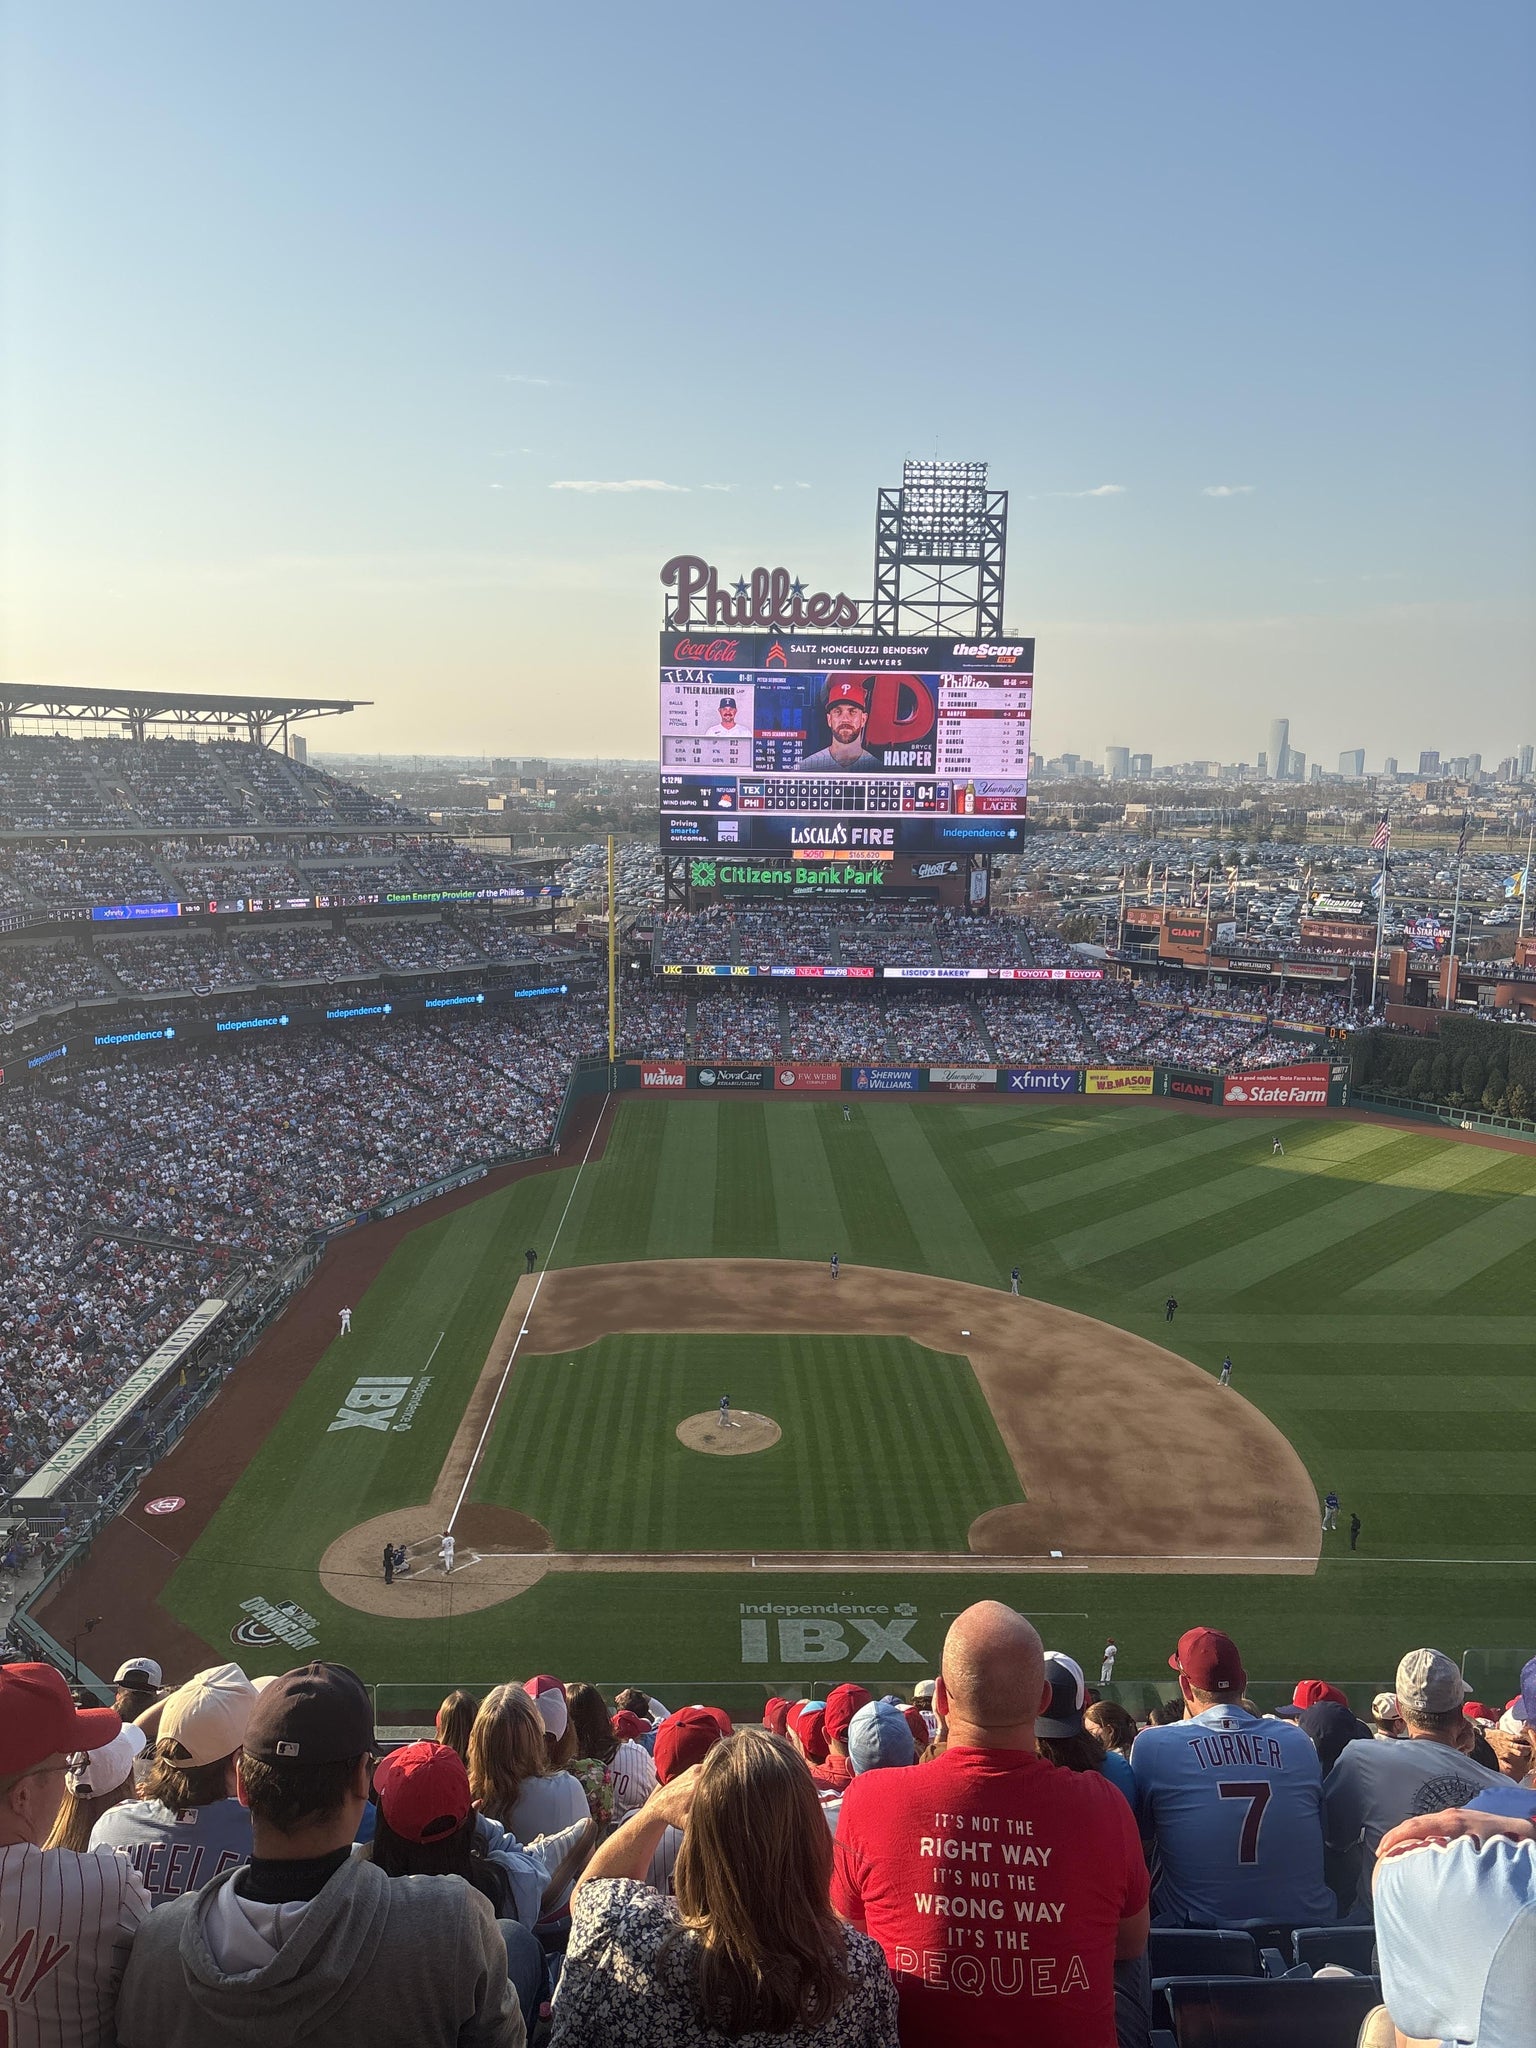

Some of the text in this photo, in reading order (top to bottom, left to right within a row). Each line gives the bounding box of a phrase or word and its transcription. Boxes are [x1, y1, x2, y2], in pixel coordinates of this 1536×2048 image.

[660, 554, 859, 628] Phillies
[790, 645, 929, 655] SALTZ MONGELUZZI BENDESKY
[952, 644, 1024, 656] theScore
[664, 669, 714, 684] TEXAS
[940, 674, 989, 689] Phillies
[683, 686, 735, 695] TYLER ALEXANDER
[883, 751, 932, 767] HARPER
[743, 786, 760, 794] TEX
[918, 786, 933, 799] 0-1
[978, 782, 1025, 795] Yuengling
[744, 799, 760, 807] PHI
[983, 802, 1018, 811] LAGER
[670, 820, 698, 828] Driving
[851, 828, 894, 845] FIRE
[943, 828, 1006, 839] Independence
[720, 866, 884, 885] Citizens Bank Park
[919, 861, 949, 877] GHOST
[386, 893, 411, 902] Clean
[412, 892, 441, 902] Energy
[442, 890, 476, 899] Provider
[477, 890, 486, 898] of
[486, 889, 498, 898] the
[499, 888, 525, 897] Phillies
[1315, 893, 1365, 909] Fitzpatrick
[103, 909, 124, 917] xfinity
[151, 907, 168, 915] Speed
[1171, 928, 1201, 938] GIANT
[1404, 925, 1452, 938] ALL STAR GAME
[662, 965, 750, 975] UKG UKG UKG
[901, 969, 970, 977] LISCIO'S BAKERY
[1016, 970, 1050, 978] TOYOTA
[514, 986, 560, 998] Independence
[425, 995, 476, 1008] Independence
[326, 1005, 382, 1019] Independence
[216, 1016, 278, 1031] Independence
[94, 1030, 162, 1046] Independence
[1339, 1031, 1347, 1040] 15
[28, 1049, 62, 1069] Independence
[643, 1072, 683, 1086] Wawa
[717, 1070, 762, 1081] NovaCare
[798, 1073, 837, 1081] F.W. WEBB
[870, 1069, 912, 1079] SHERWIN
[942, 1070, 985, 1081] Yuengling
[1011, 1071, 1071, 1090] xfinity
[869, 1079, 913, 1089] WILLIAMS.
[1171, 1082, 1213, 1097] GIANT
[1460, 1120, 1473, 1130] 401
[157, 1313, 214, 1358] WELCOME
[326, 1376, 414, 1432] IBX
[400, 1376, 436, 1423] Independence
[43, 1377, 152, 1474] Citizens Bank Park
[739, 1602, 889, 1617] Independence
[239, 1595, 321, 1651] OPENING DAY
[739, 1618, 929, 1665] IBX
[1187, 1733, 1284, 1771] TURNER
[935, 1812, 1034, 1836] IT'S NOT THE
[1215, 1780, 1273, 1866] 7
[919, 1836, 1052, 1867] RIGHT WAY
[932, 1867, 1036, 1891] IT'S NOT THE
[914, 1892, 1066, 1923] WRONG WAY
[948, 1926, 1030, 1950] IT'S THE
[895, 1945, 1090, 1997] PEQUEA
